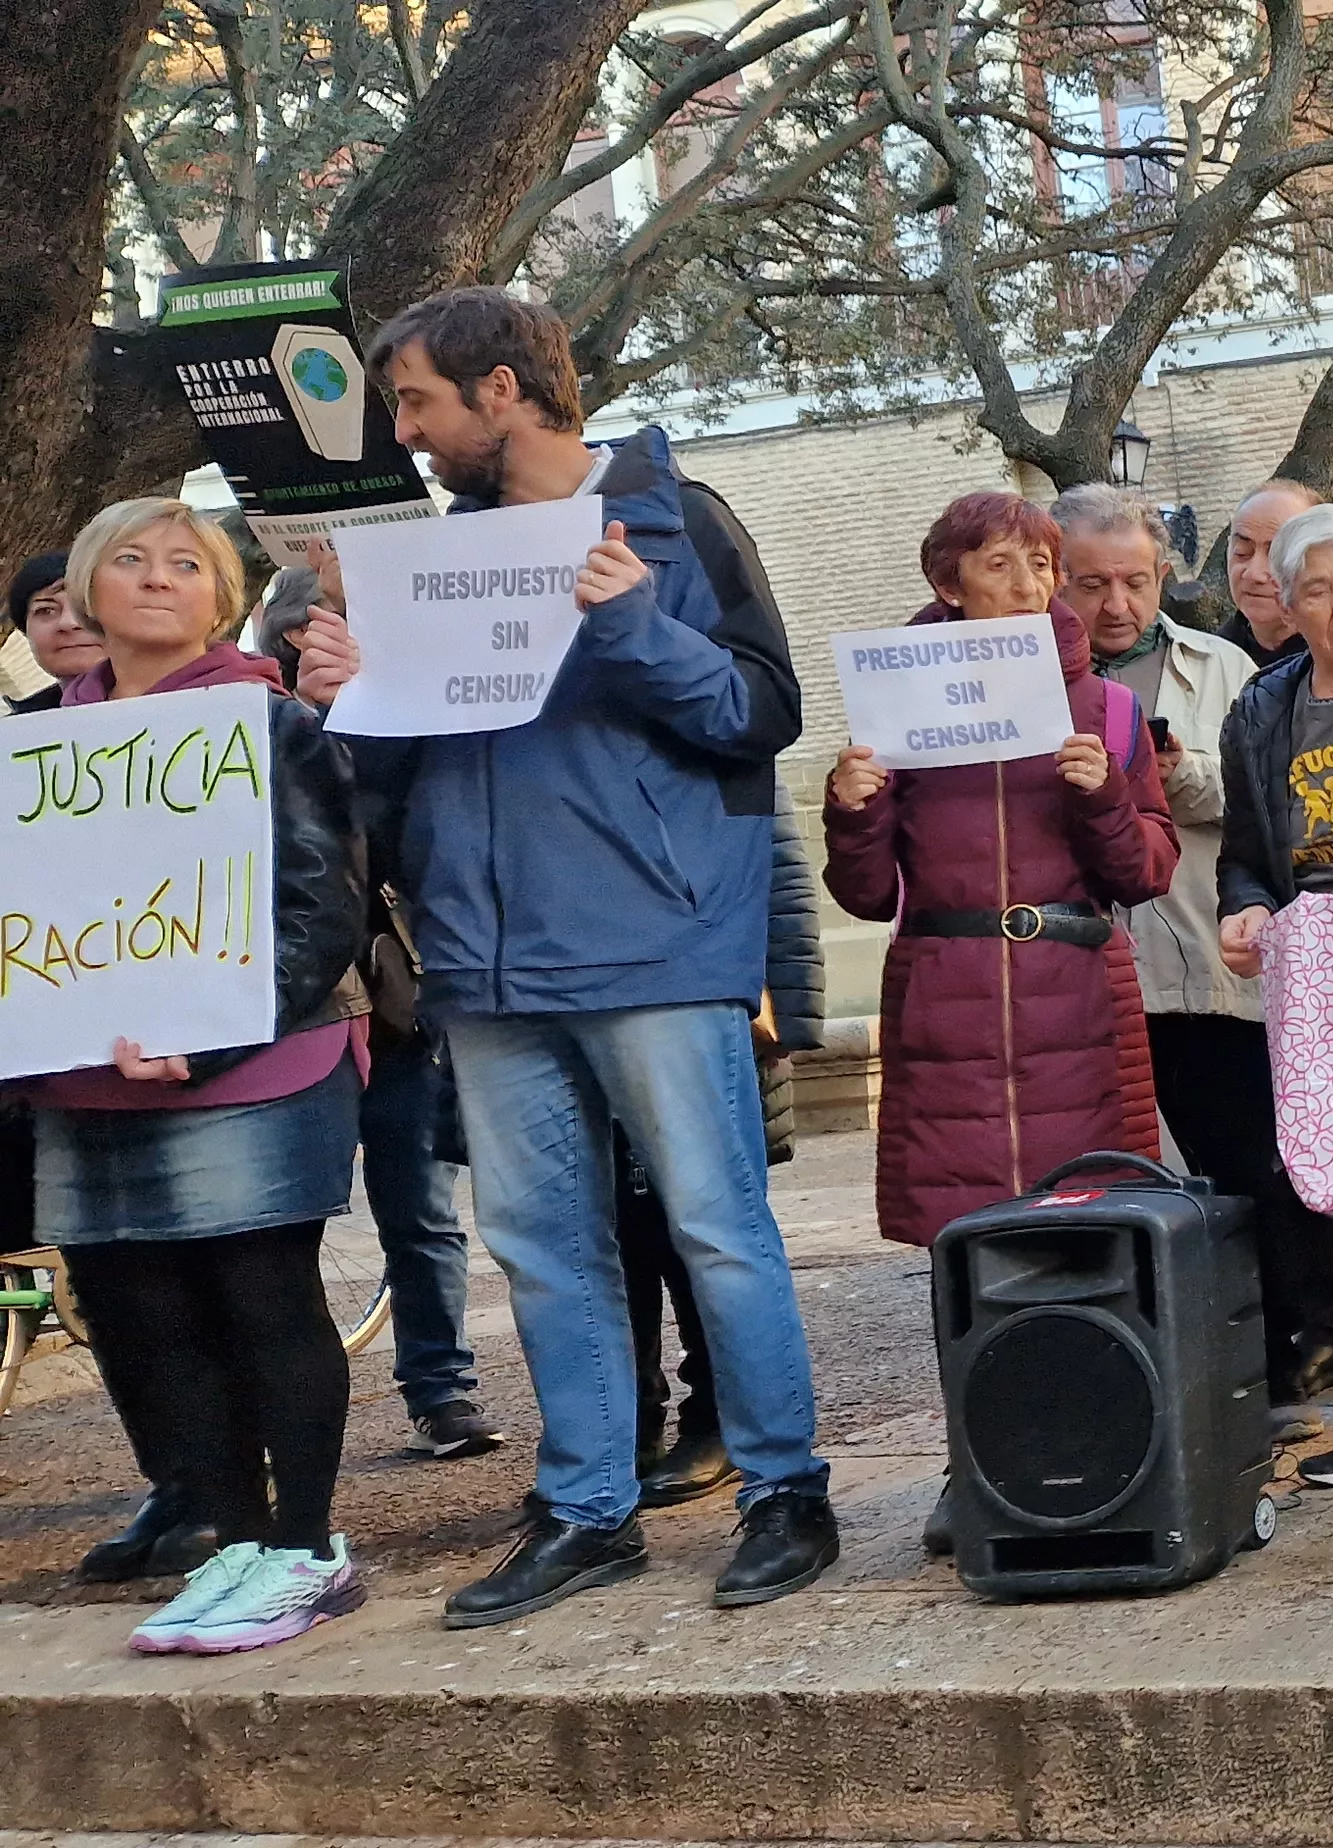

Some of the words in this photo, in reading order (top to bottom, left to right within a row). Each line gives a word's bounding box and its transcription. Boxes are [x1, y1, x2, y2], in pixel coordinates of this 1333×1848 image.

[171, 293, 200, 313] ¡NOS
[203, 287, 254, 309] QUIEREN
[257, 281, 325, 304] ENTERRAR!
[175, 357, 272, 383] ENTIERRO
[183, 380, 213, 397] POR
[219, 379, 239, 394] LA
[189, 391, 267, 412] COOPERACIÓN
[196, 407, 285, 428] INTERNACIONAL
[491, 621, 529, 650] SIN
[852, 633, 1039, 672] PRESUPUESTOS
[945, 680, 986, 706] SIN
[906, 719, 1020, 751] CENSURA
